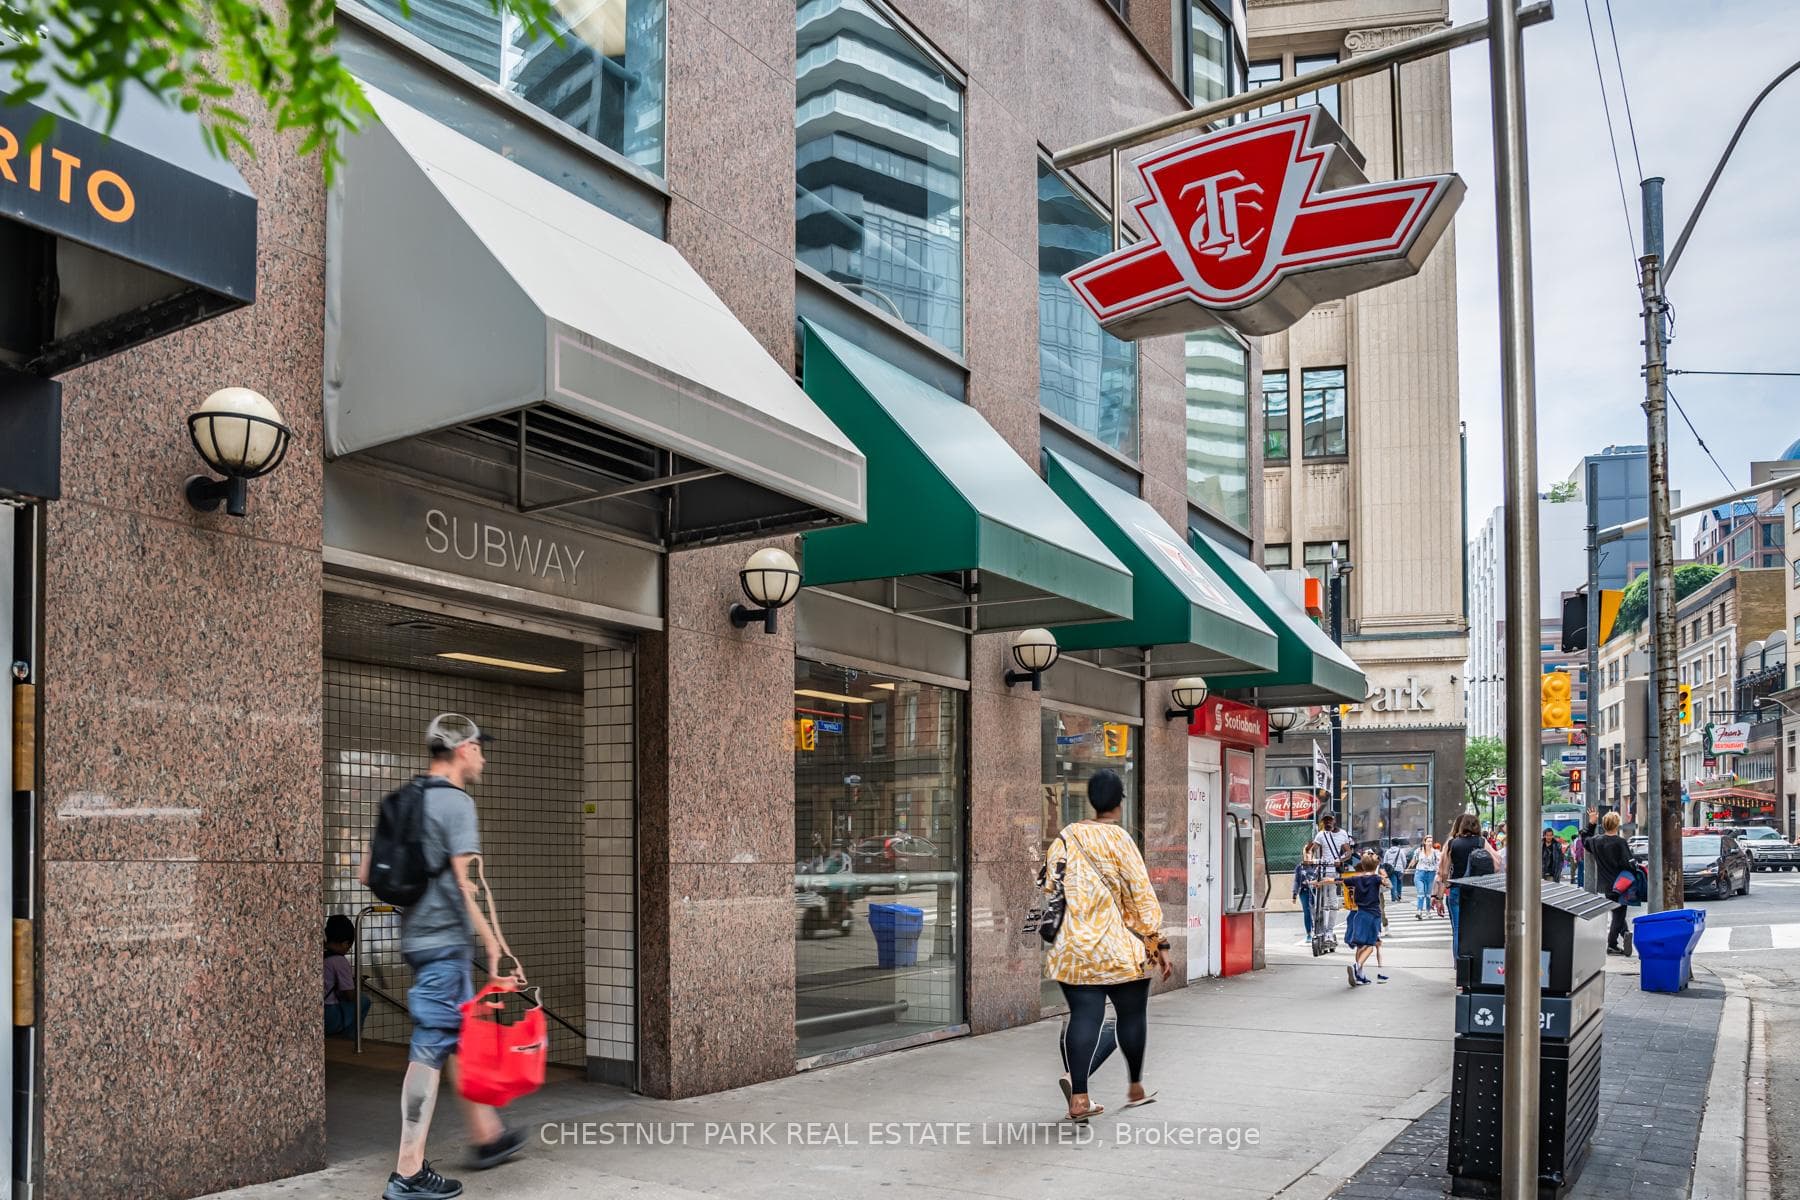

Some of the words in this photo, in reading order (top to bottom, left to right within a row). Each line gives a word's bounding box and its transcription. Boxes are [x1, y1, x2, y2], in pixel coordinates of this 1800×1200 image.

[1178, 169, 1265, 262] TTC
[425, 509, 585, 586] SUBWAY
[1224, 711, 1261, 735] Scotiabank
[1189, 788, 1206, 801] ou're
[1265, 799, 1281, 809] Tim
